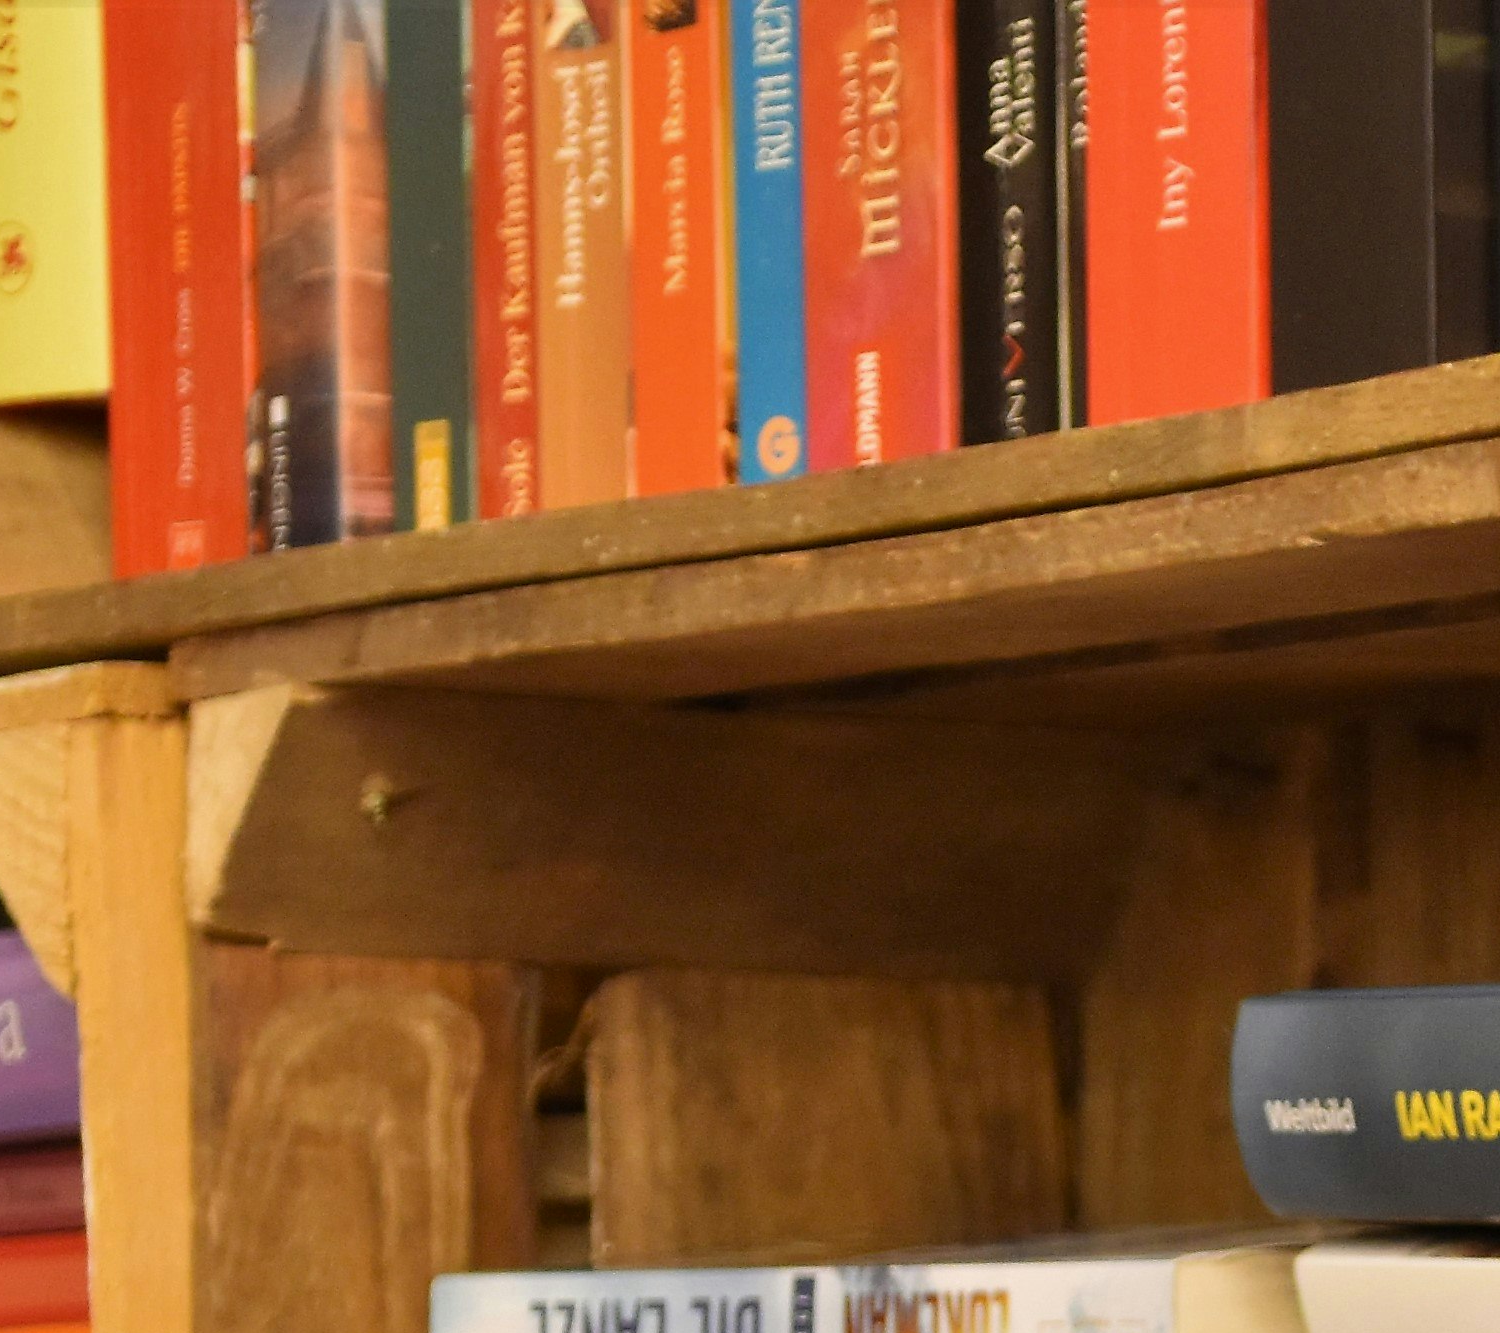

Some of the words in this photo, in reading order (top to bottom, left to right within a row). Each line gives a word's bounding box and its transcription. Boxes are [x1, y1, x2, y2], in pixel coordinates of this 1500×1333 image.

[755, 74, 795, 171] RUTH
[1156, 157, 1197, 232] Iny
[1396, 1088, 1455, 1141] IAN
